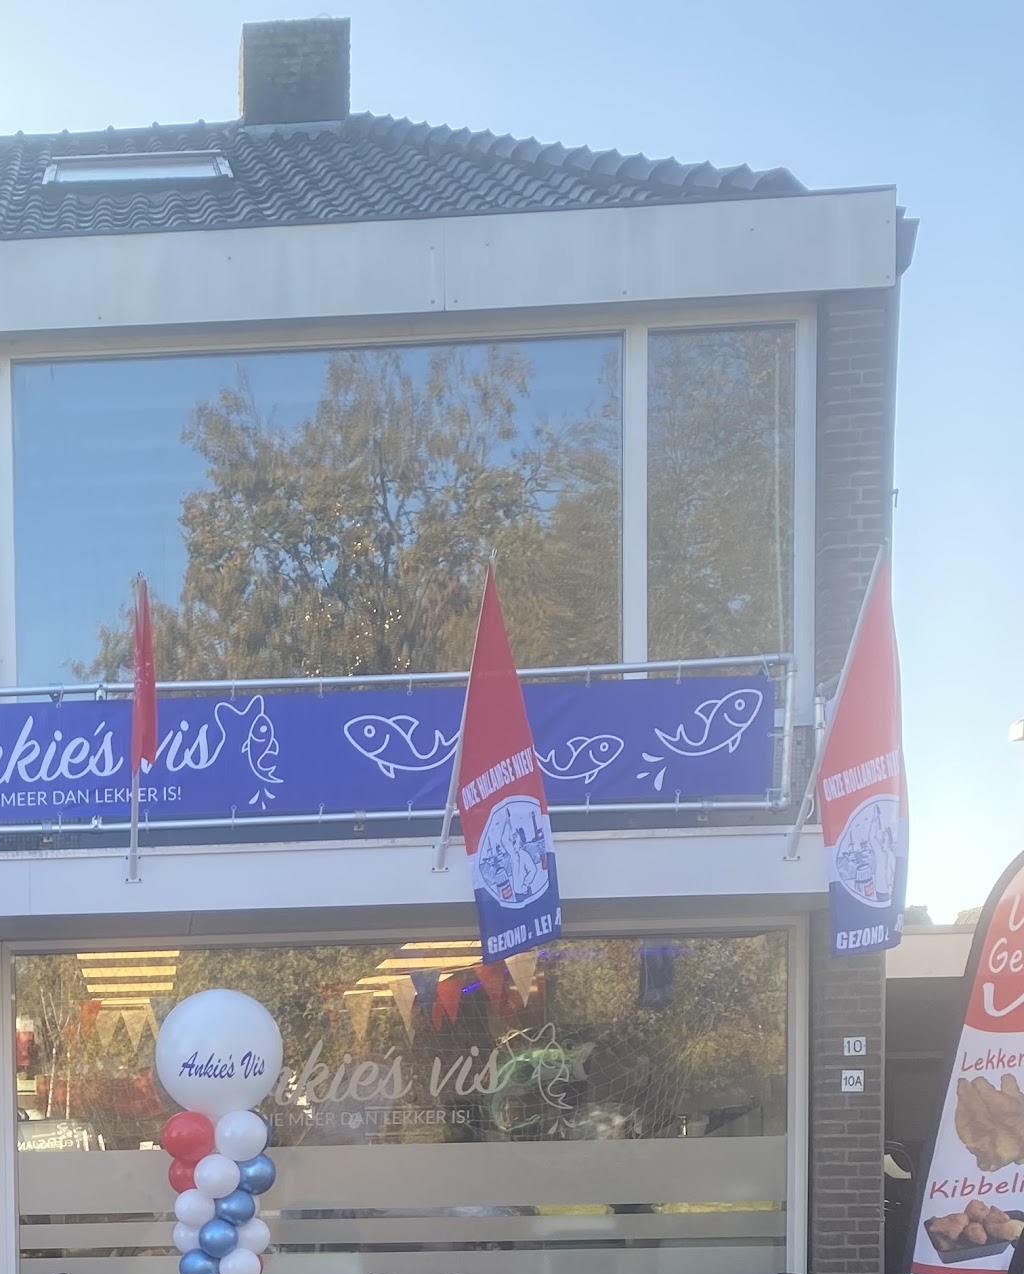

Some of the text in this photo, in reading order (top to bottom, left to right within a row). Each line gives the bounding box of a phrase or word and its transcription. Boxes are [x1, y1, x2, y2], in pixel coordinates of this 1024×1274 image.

[823, 773, 845, 801] ONZE
[843, 755, 887, 794] HOLLANDSE
[1, 791, 48, 807] MEER
[52, 789, 90, 805] DAN
[95, 788, 158, 804] LEKKER
[163, 786, 182, 801] IS!
[836, 924, 883, 949] GEZOND
[846, 1039, 863, 1054] 10
[179, 1050, 265, 1080] Ankie's Vis
[843, 1075, 862, 1087] 10A
[289, 1112, 335, 1127] MEER
[341, 1111, 377, 1126] DAN
[384, 1110, 446, 1126] LEKKER
[451, 1109, 470, 1124] IS!
